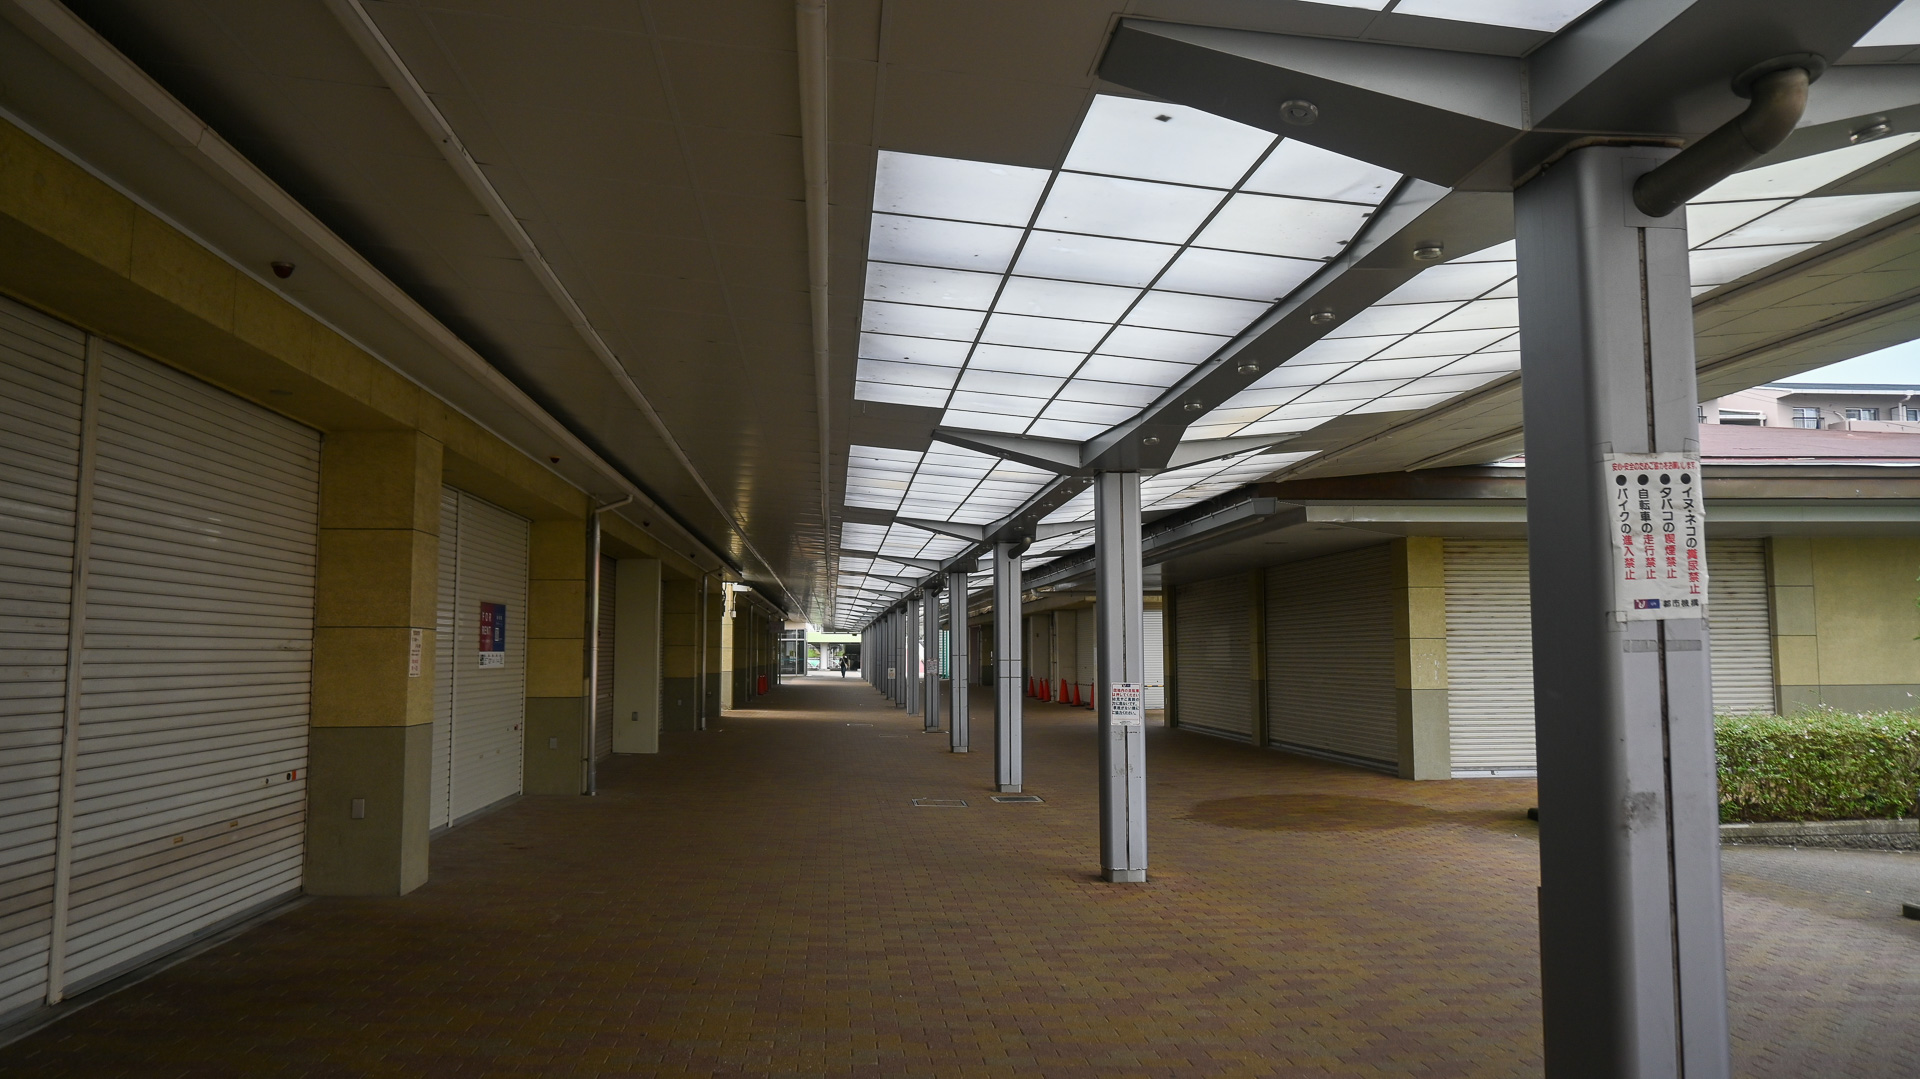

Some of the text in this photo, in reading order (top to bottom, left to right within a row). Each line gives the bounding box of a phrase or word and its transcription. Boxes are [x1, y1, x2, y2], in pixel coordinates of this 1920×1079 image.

[1617, 488, 1636, 581] バイクの進入禁止
[1638, 488, 1657, 580] 自転車の走行禁止
[1659, 487, 1678, 579] タバコの喫煙禁止
[1663, 598, 1700, 608] 都市機構
